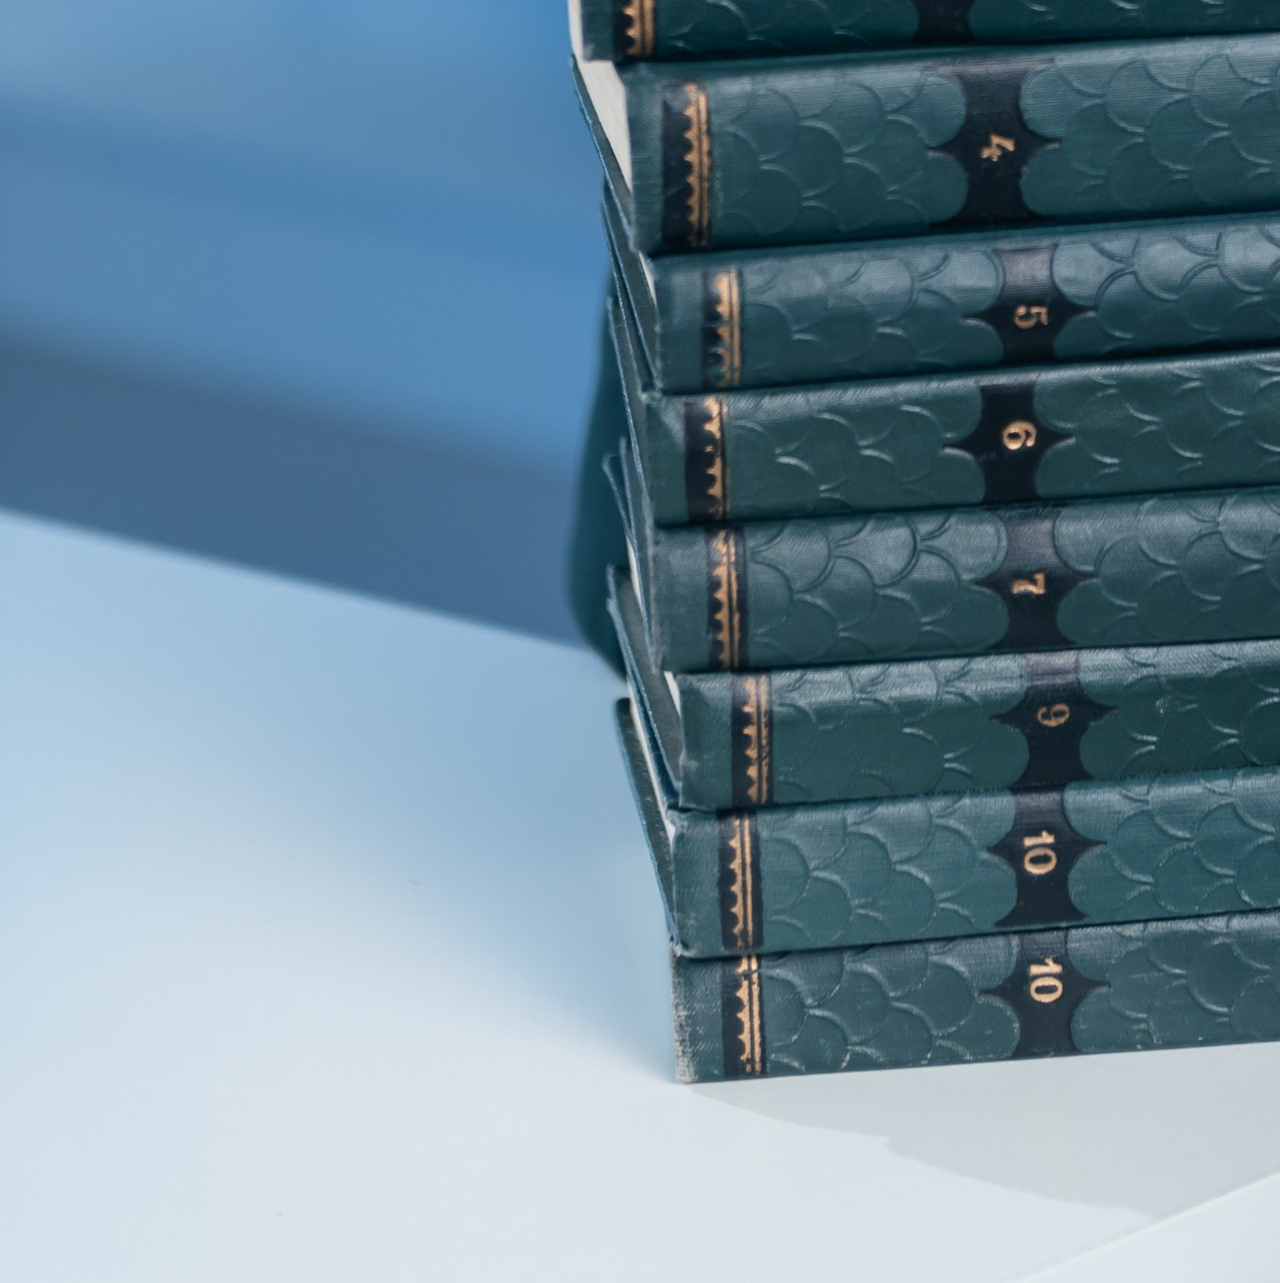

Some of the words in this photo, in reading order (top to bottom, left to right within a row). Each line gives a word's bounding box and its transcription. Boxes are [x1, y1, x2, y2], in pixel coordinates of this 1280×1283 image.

[981, 134, 1015, 160] 4
[1014, 305, 1048, 328] 5
[1002, 421, 1037, 451] 6
[1012, 572, 1045, 595] 7
[1036, 703, 1068, 727] 9
[1022, 831, 1057, 875] 10
[1029, 957, 1063, 1003] 10
